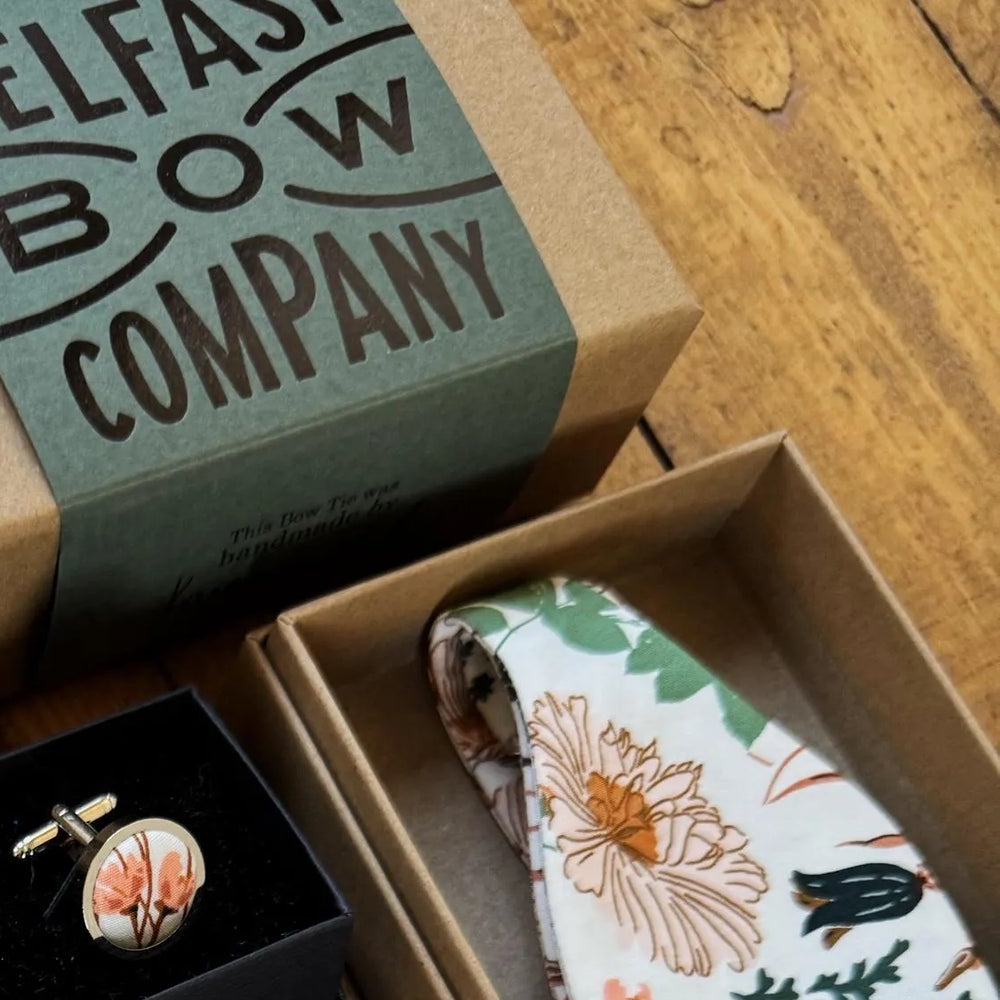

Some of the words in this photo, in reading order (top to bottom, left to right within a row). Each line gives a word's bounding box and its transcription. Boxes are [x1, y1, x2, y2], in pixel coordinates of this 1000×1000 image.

[62, 220, 505, 442] COMPANY
[231, 518, 273, 544] This
[280, 504, 321, 526] Bow
